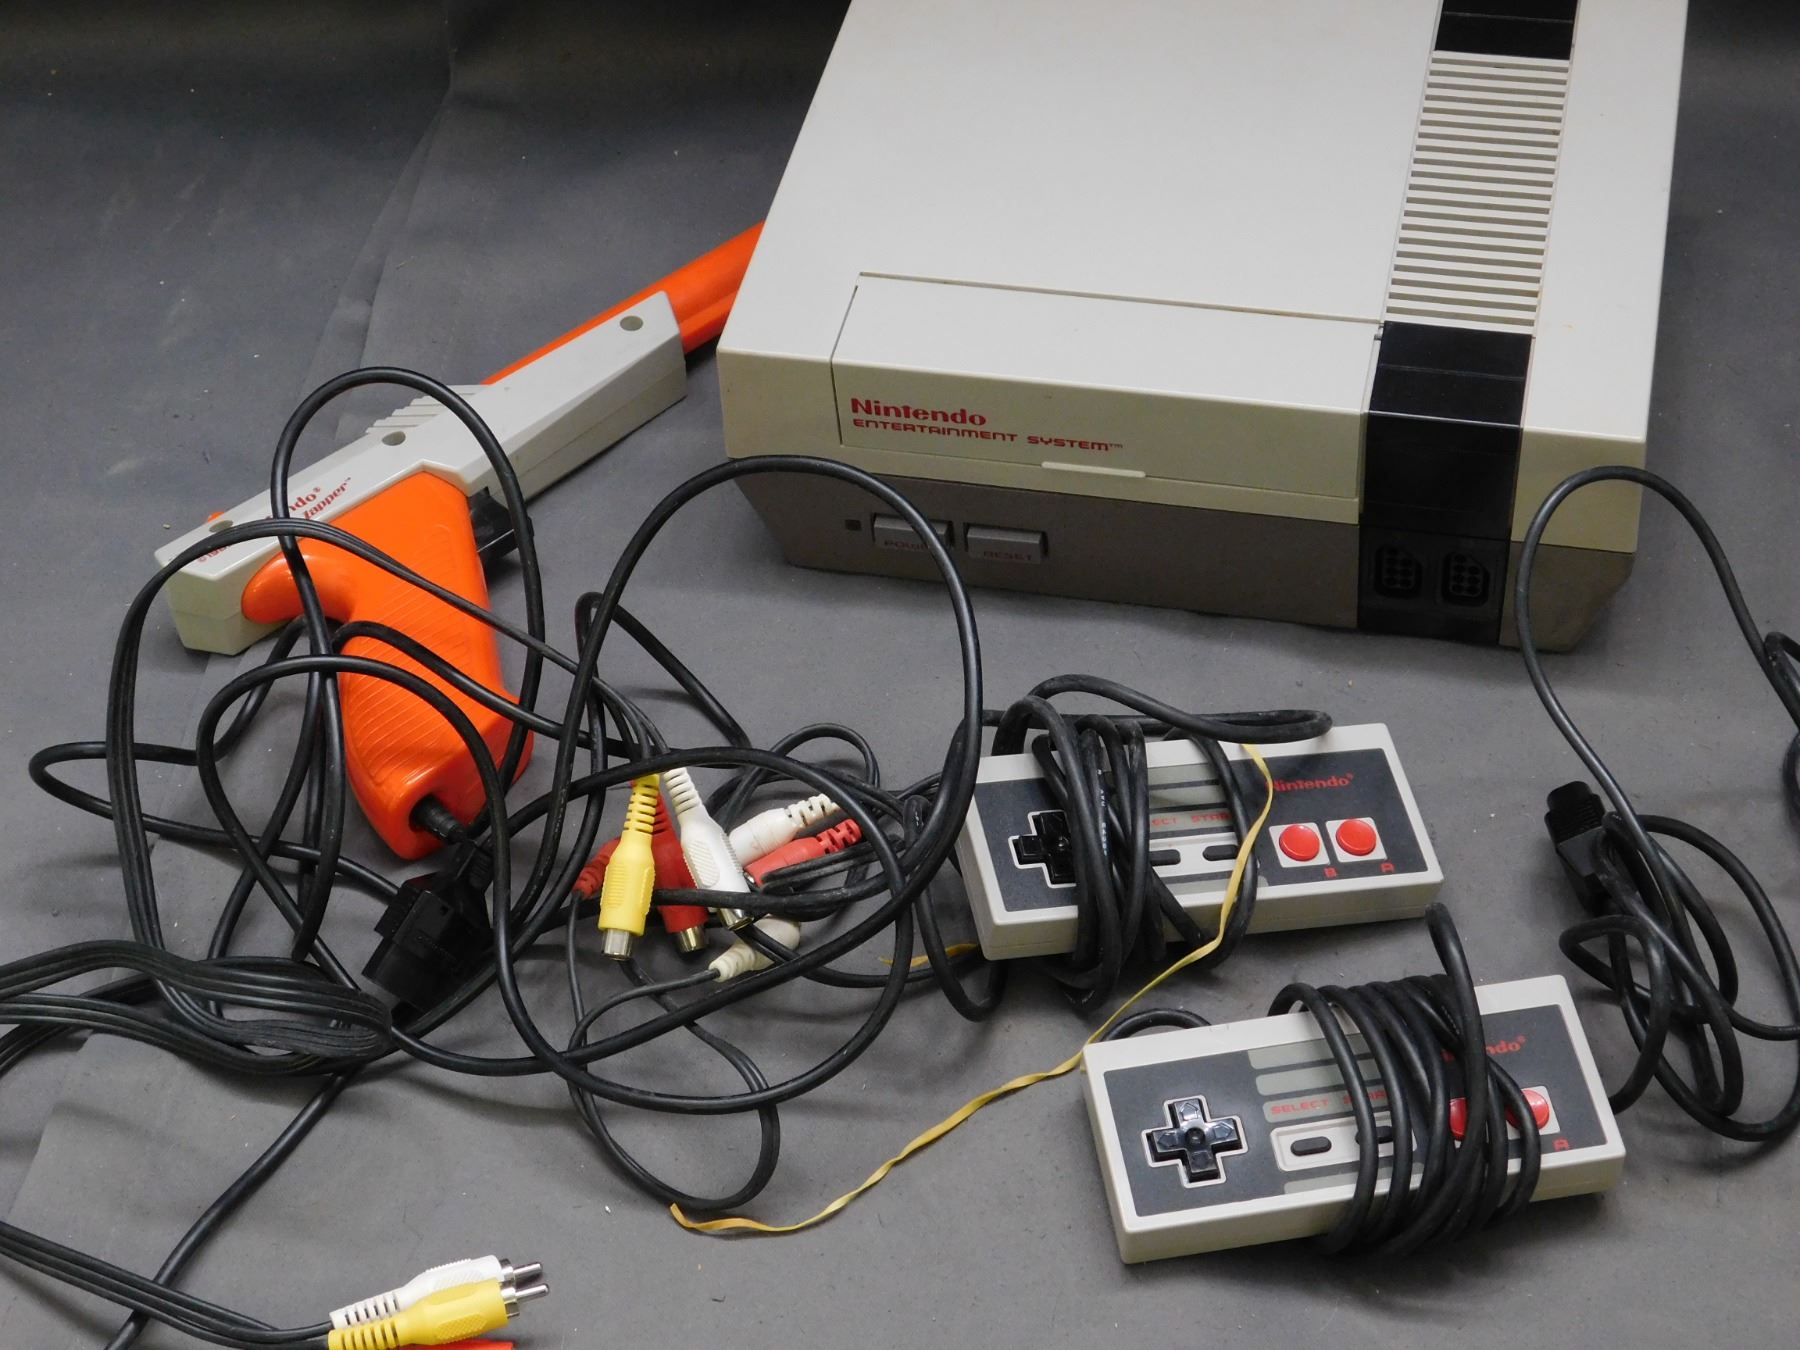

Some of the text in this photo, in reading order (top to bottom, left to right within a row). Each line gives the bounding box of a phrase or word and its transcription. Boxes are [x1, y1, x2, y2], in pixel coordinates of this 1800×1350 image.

[850, 397, 987, 426] Nintendo
[853, 418, 1018, 442] ENTERTAINMENT
[1323, 861, 1396, 878] B A
[1269, 1097, 1331, 1116] SELECT
[1552, 1137, 1570, 1152] A
